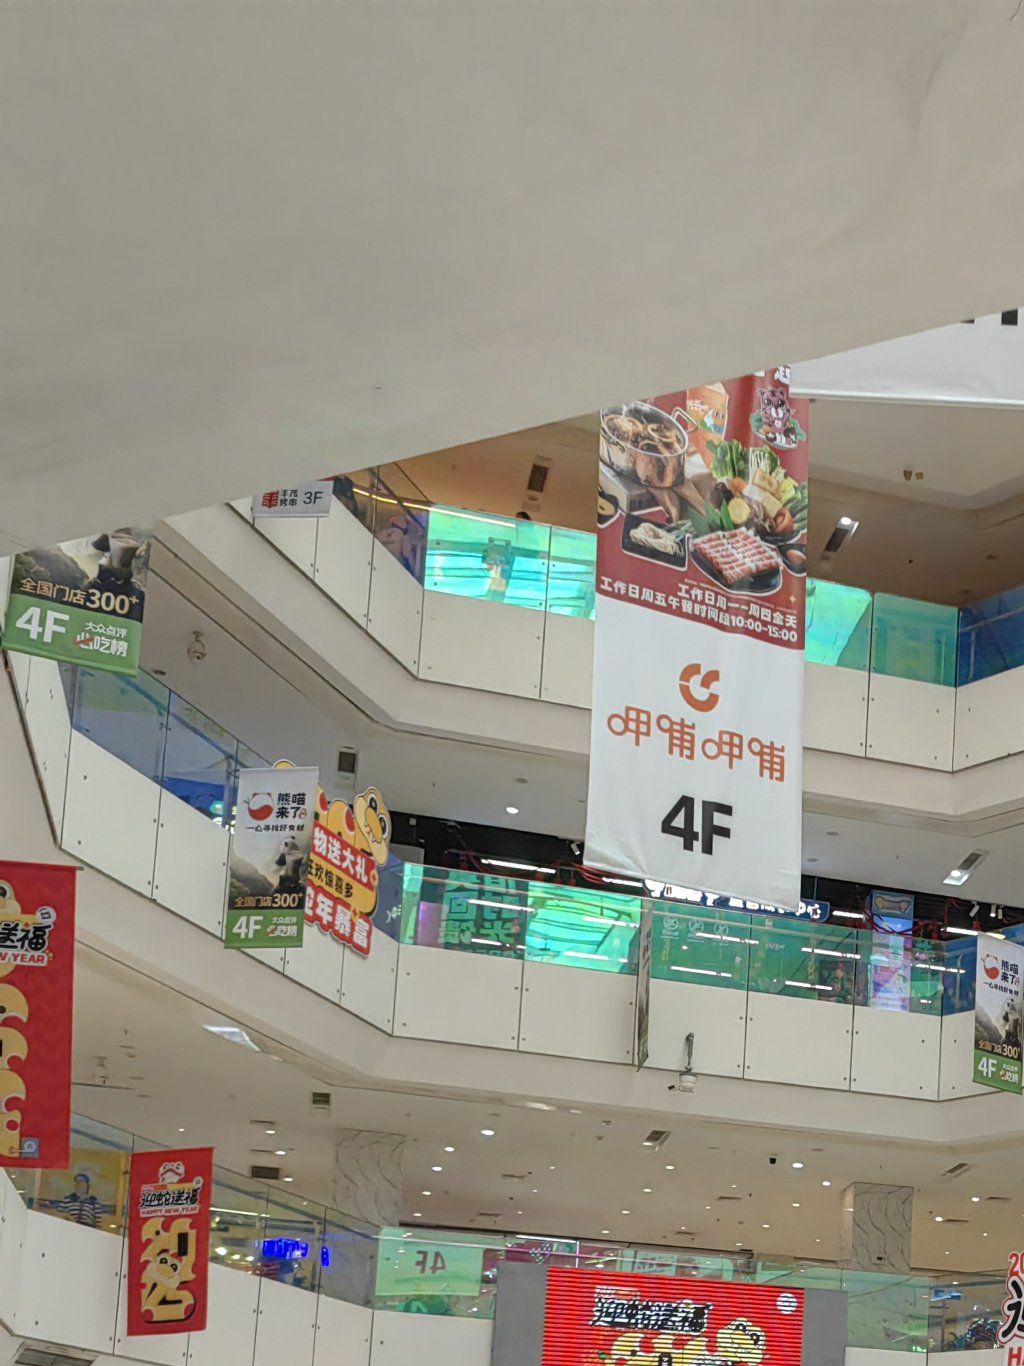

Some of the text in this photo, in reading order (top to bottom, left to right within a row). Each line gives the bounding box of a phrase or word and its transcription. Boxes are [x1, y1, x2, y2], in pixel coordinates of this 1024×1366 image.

[302, 490, 324, 506] 3F
[15, 606, 70, 643] 4F
[84, 621, 128, 638] 大众点评
[73, 631, 128, 658] 必吃榜
[606, 705, 785, 783] 呷哺呷哺
[276, 792, 306, 806] 熊喵
[276, 806, 301, 820] 来了
[660, 795, 733, 855] 4F
[232, 915, 264, 939] 4F
[12, 953, 45, 963] YEAR
[977, 1056, 998, 1078] 4F
[139, 1188, 200, 1208] 迎蛇送福
